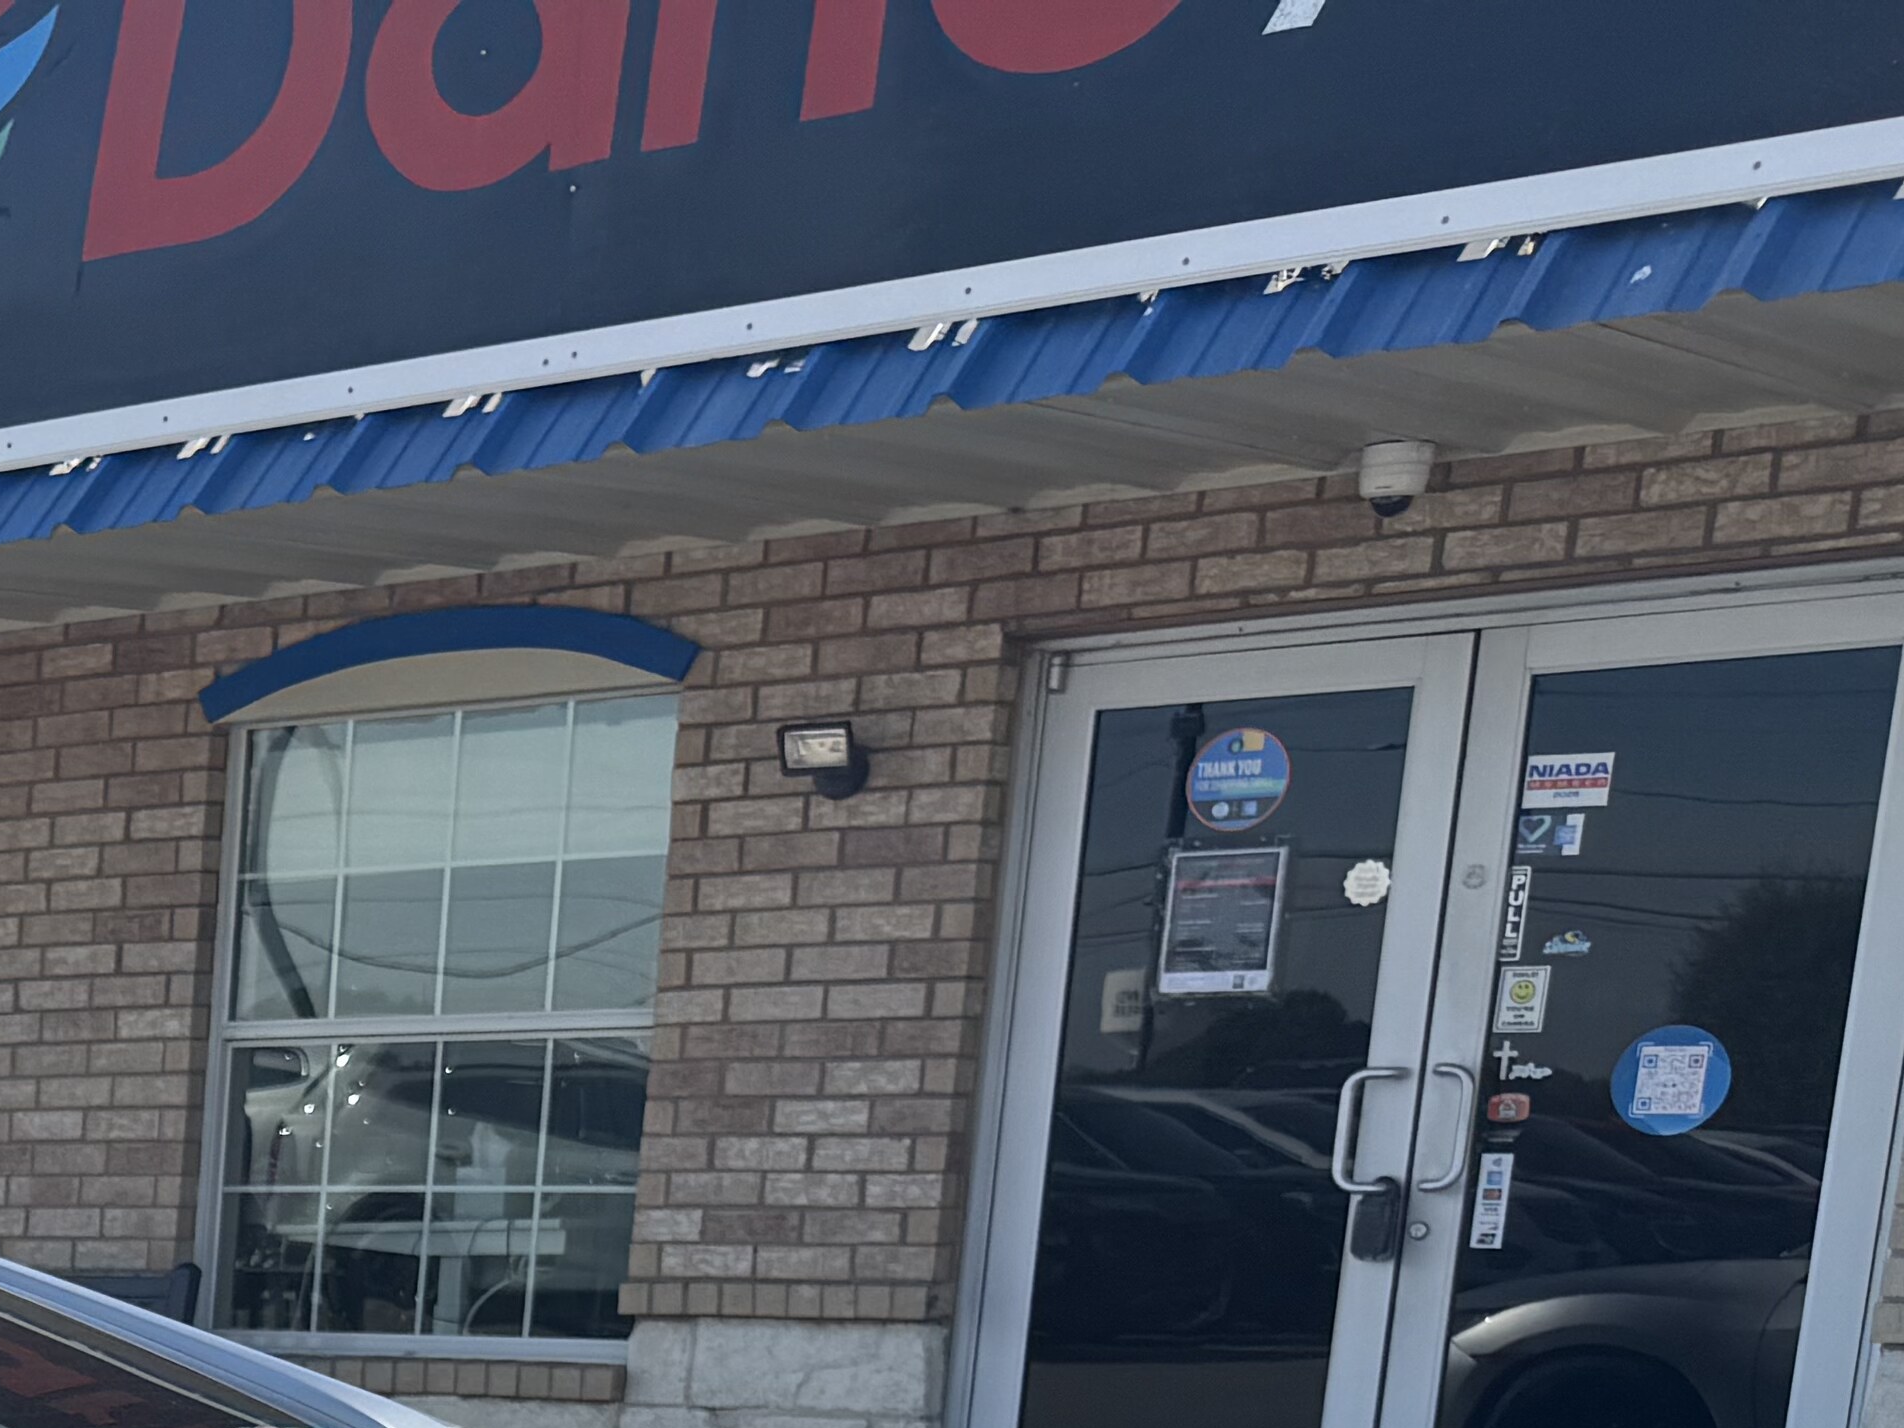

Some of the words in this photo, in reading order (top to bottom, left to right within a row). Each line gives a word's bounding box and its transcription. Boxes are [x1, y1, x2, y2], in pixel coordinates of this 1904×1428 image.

[1197, 760, 1236, 778] THANK
[1238, 759, 1262, 776] YOU
[1528, 762, 1610, 778] NIADA
[1504, 875, 1526, 938] PULL
